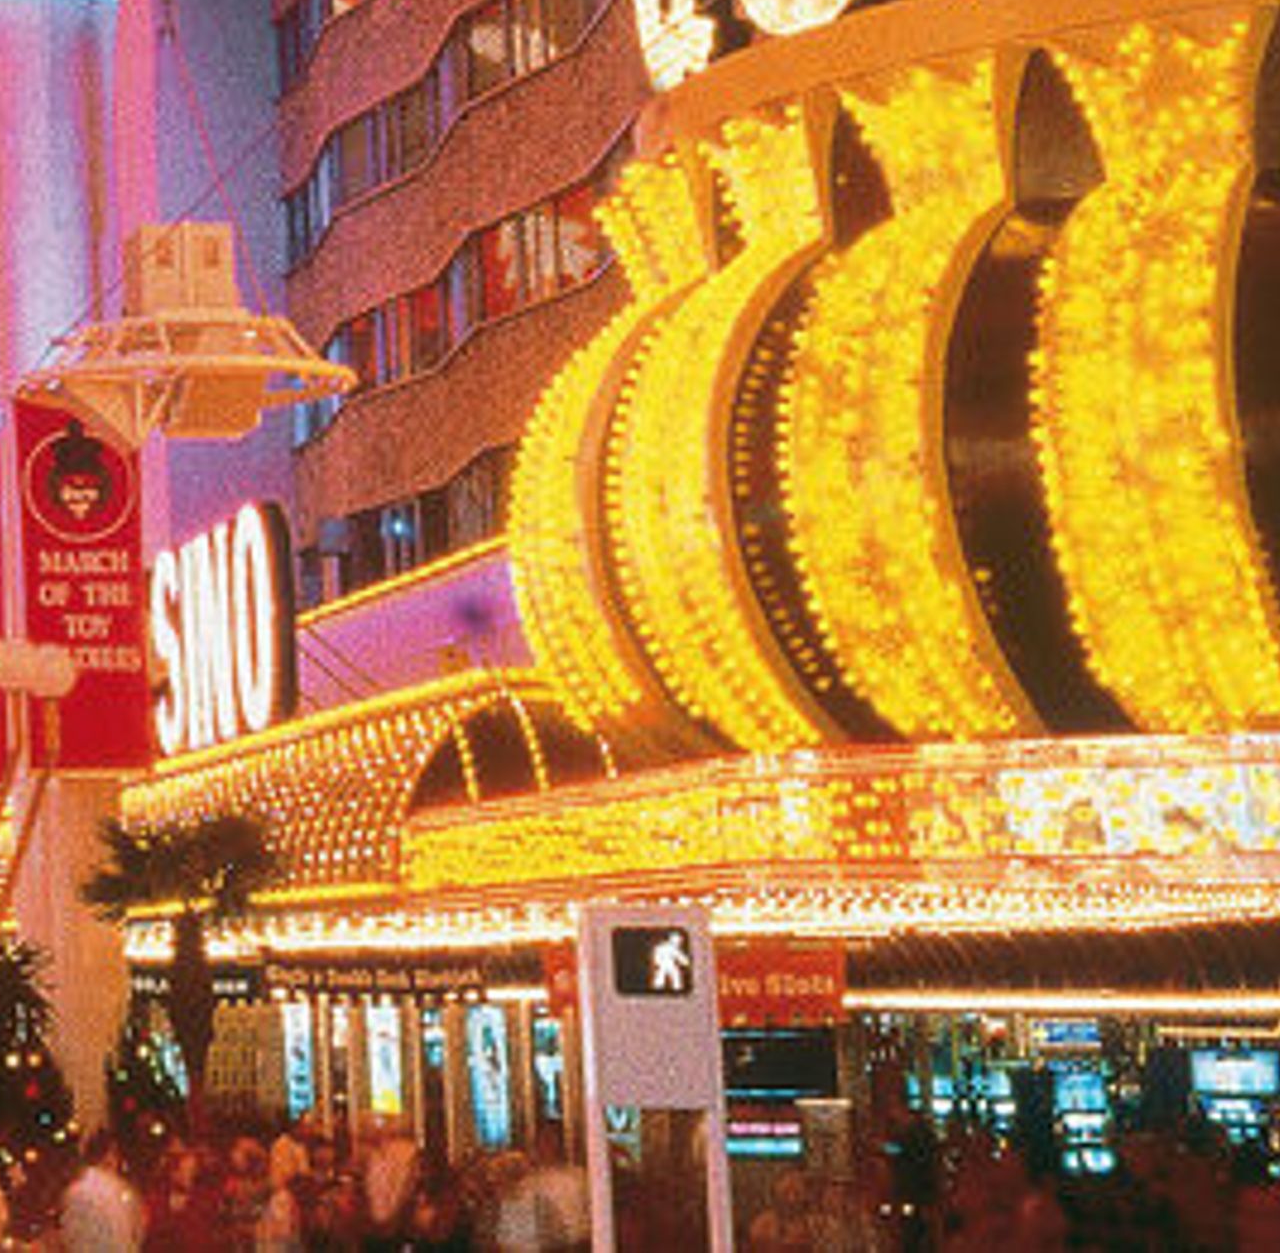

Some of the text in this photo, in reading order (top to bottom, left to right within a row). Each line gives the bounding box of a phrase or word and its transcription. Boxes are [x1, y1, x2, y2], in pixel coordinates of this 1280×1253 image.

[38, 550, 129, 574] MARCH
[38, 580, 131, 606] OF THE
[62, 613, 112, 639] TOY
[150, 503, 275, 757] SINO
